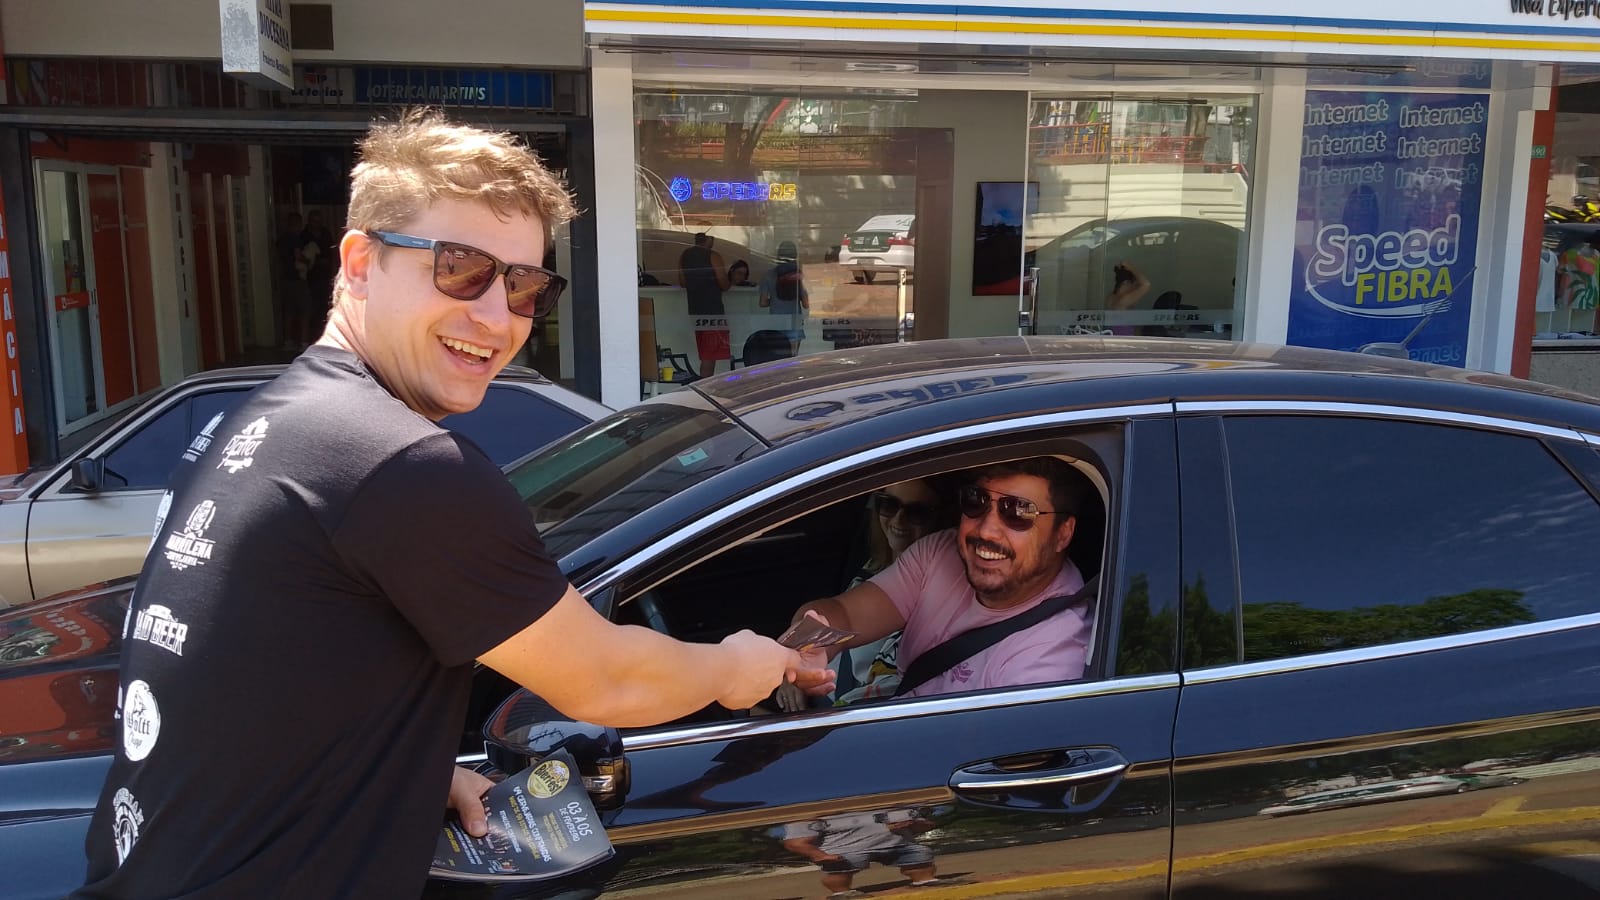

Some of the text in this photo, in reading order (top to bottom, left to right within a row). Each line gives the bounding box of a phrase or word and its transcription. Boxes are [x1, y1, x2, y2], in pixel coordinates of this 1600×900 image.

[428, 86, 487, 101] MARTINS
[1303, 99, 1483, 128] Internet Internet
[1301, 130, 1481, 159] Internet Internet
[1300, 161, 1385, 187] Internet
[1315, 214, 1462, 287] Speed
[1355, 267, 1453, 304] FIBRA
[149, 617, 189, 657] BEER
[566, 801, 583, 816] 03
[576, 823, 593, 836] 05
